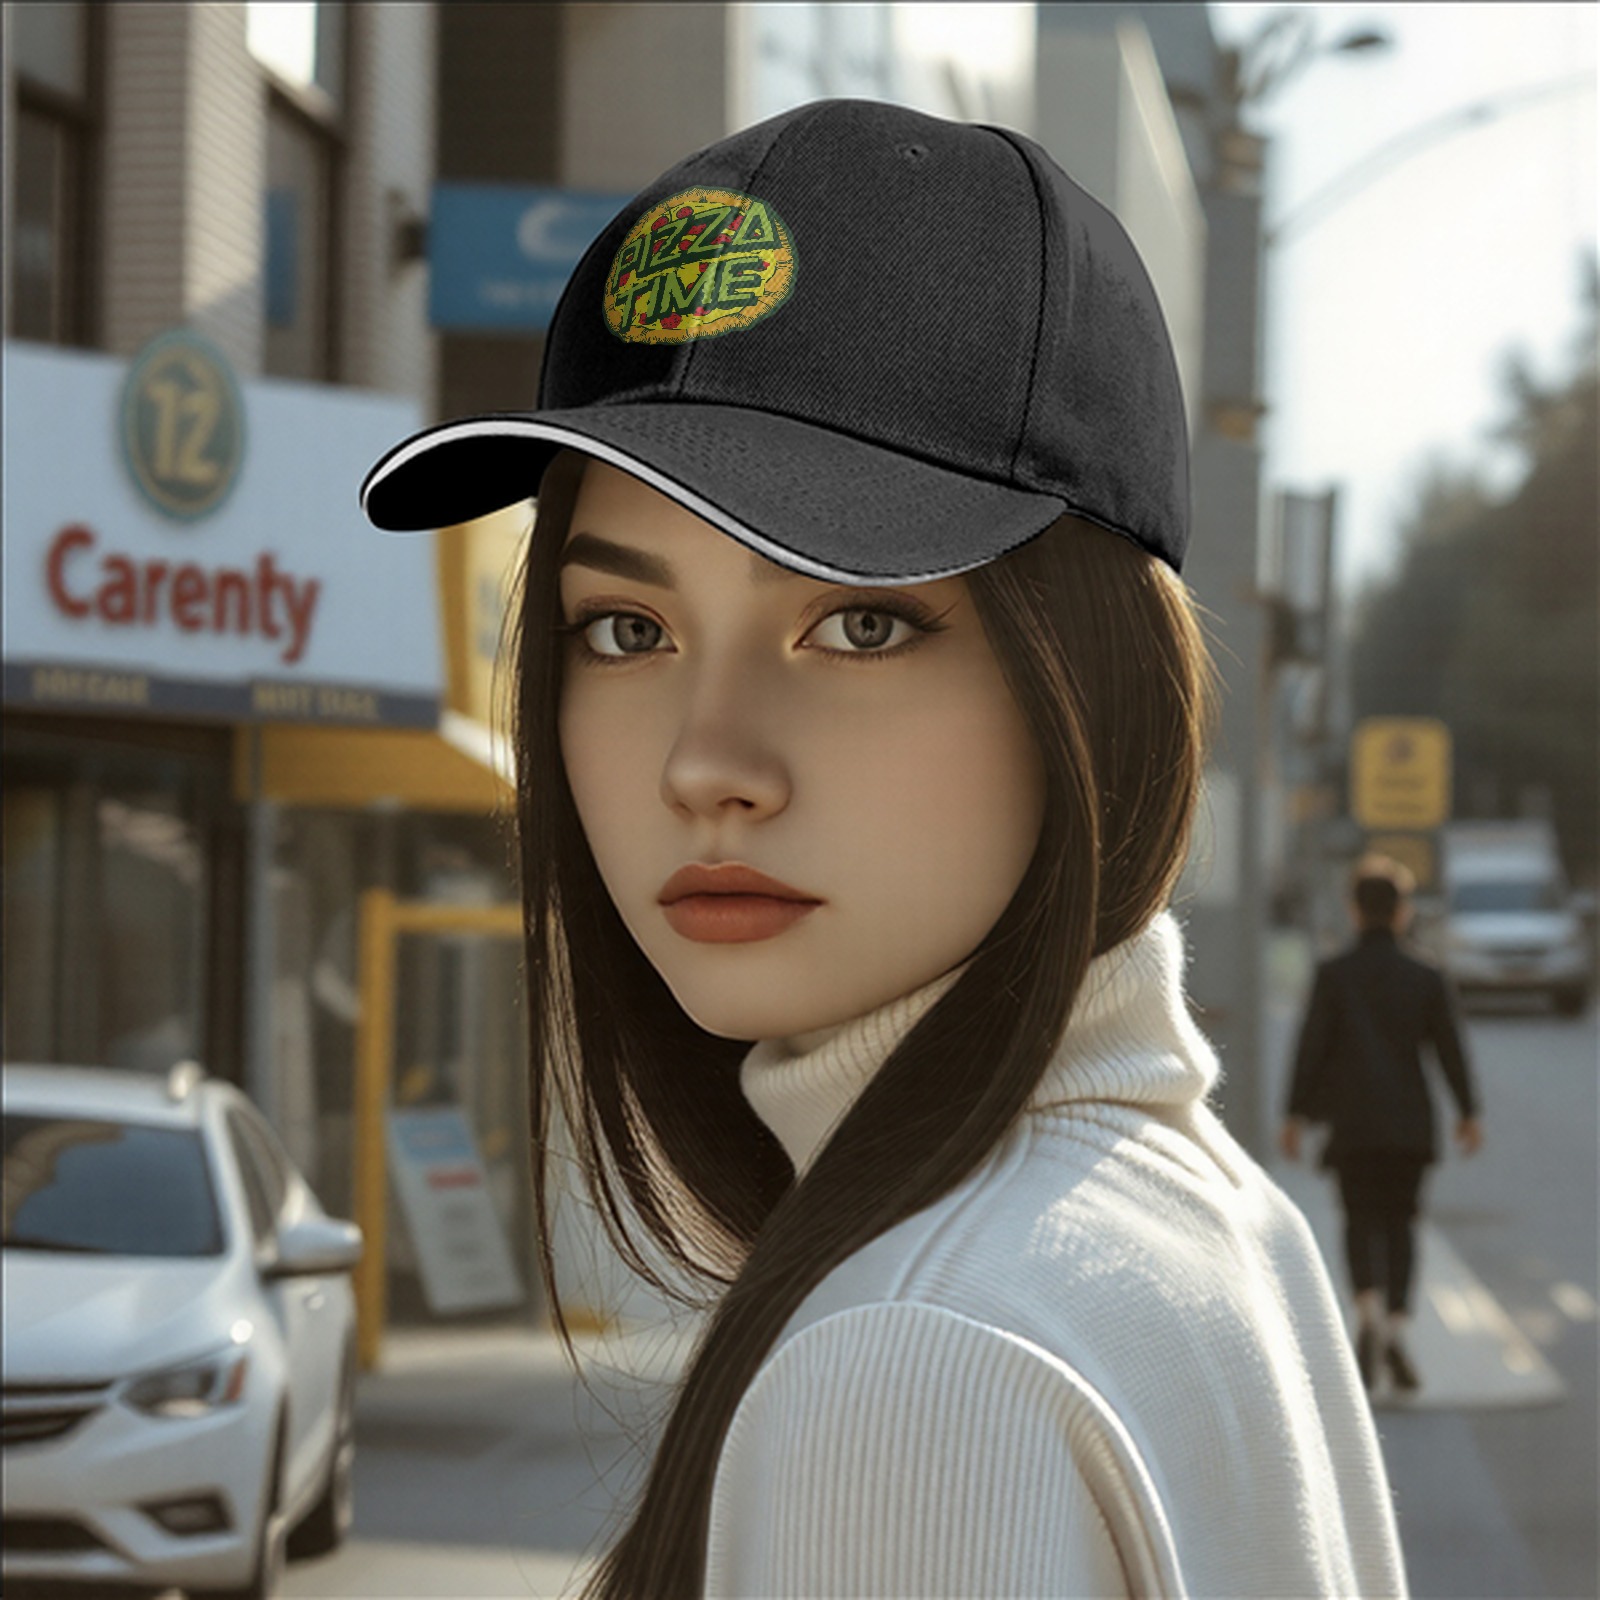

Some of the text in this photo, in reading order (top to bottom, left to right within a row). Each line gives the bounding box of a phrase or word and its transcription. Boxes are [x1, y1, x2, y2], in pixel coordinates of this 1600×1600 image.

[612, 201, 776, 290] PIZZA
[615, 256, 760, 330] TIME
[44, 522, 322, 665] Carenty
